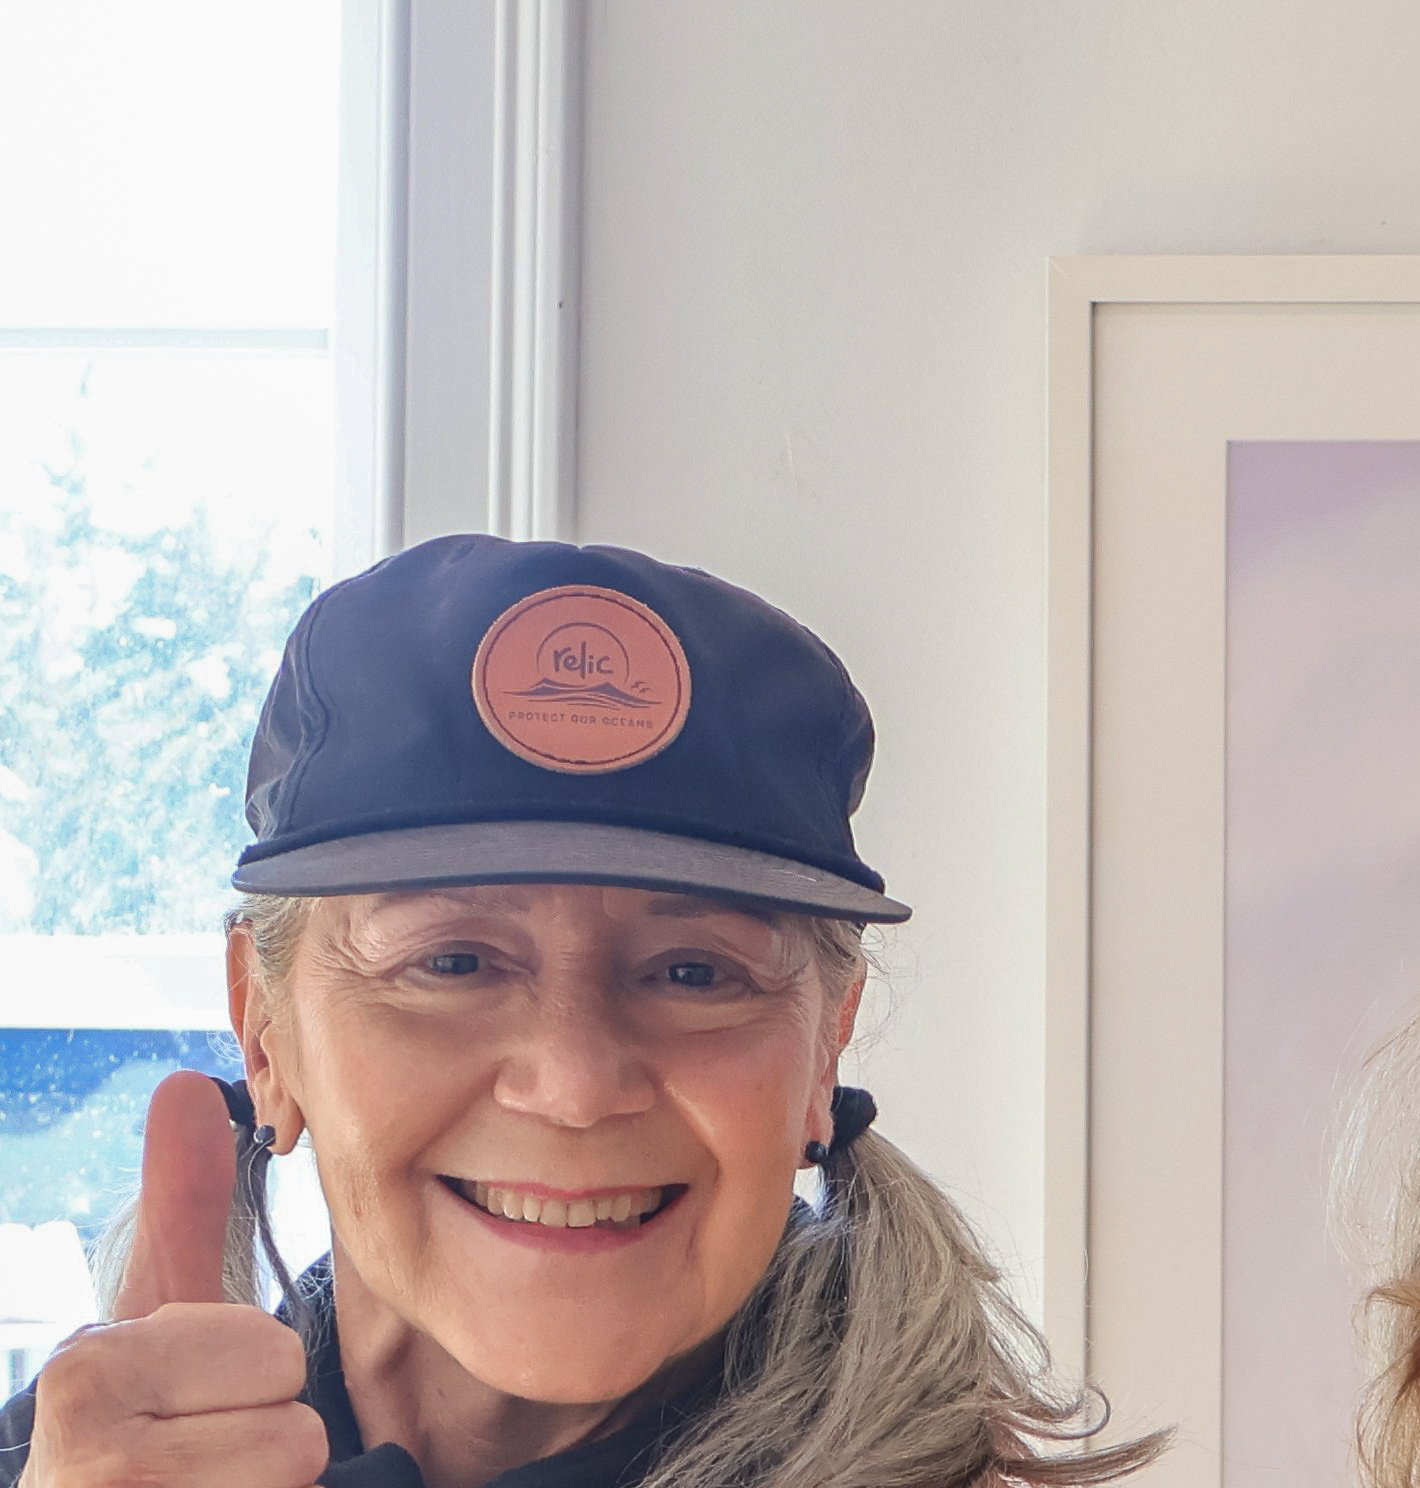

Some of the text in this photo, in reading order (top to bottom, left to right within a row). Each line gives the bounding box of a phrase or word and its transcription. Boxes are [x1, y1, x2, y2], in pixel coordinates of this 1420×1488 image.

[553, 641, 614, 680] relic
[508, 711, 654, 729] PROTECT OUR OCEANS
